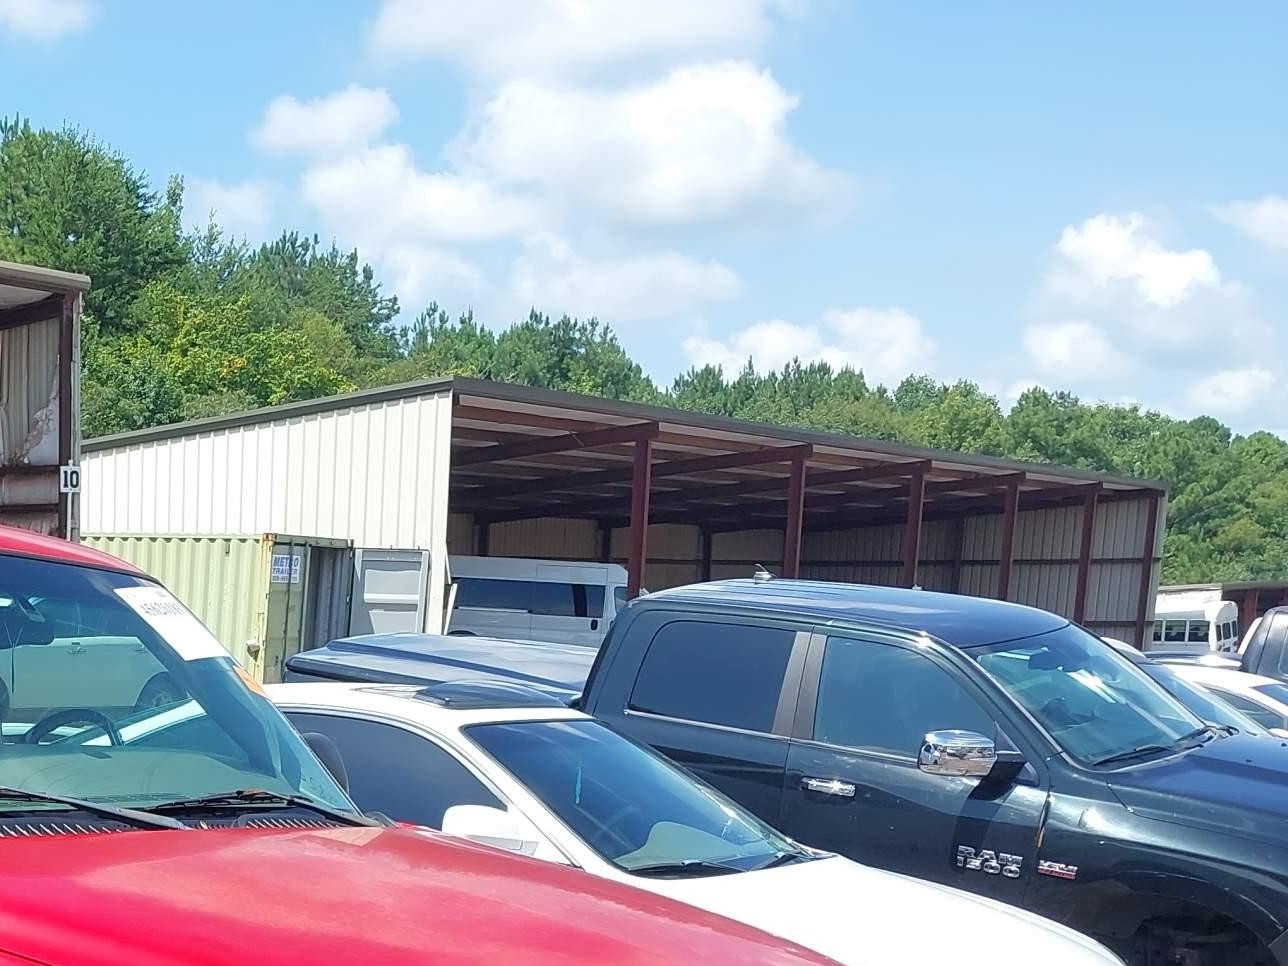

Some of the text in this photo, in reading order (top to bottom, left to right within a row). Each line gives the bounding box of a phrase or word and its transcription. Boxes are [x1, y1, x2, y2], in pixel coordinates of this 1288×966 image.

[63, 470, 79, 488] 10
[273, 556, 299, 568] METO
[956, 845, 1023, 868] RAM
